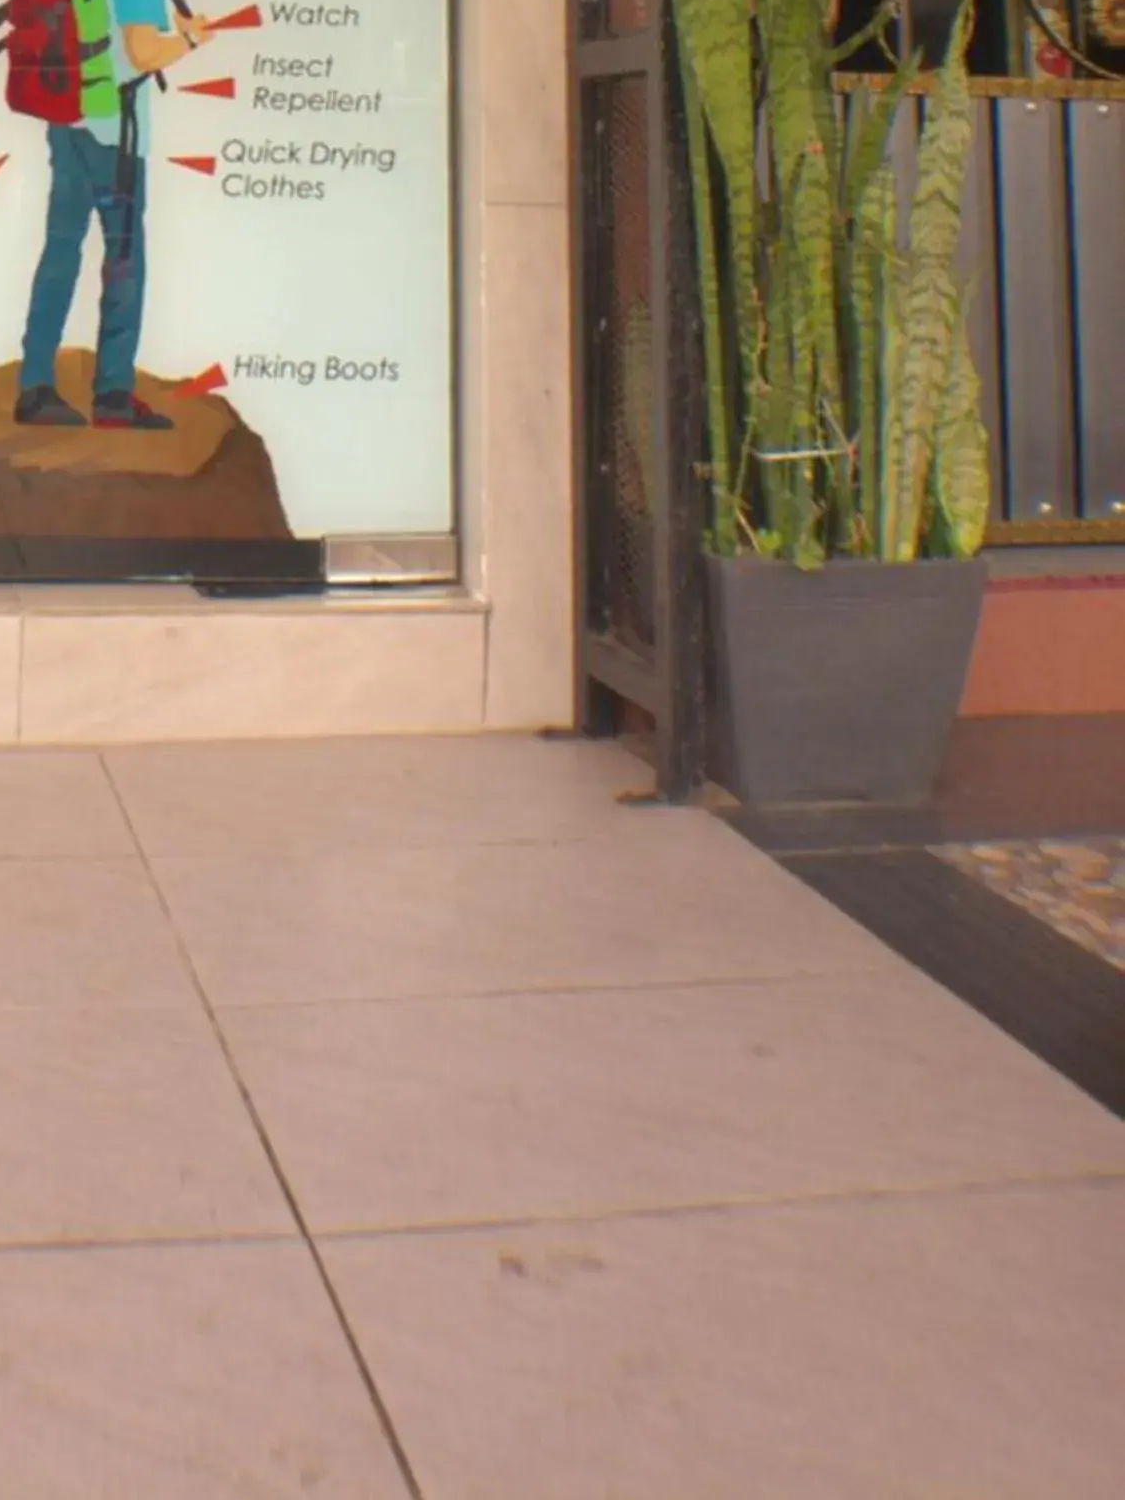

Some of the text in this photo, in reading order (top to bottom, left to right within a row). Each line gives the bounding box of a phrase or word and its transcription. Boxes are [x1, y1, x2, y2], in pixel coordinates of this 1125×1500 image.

[269, 2, 361, 28] Watch
[251, 52, 334, 79] Insect
[251, 85, 383, 115] Repellent
[220, 138, 397, 173] Quick Drying
[220, 172, 326, 200] Clothes
[233, 353, 401, 387] Hiking Boots
